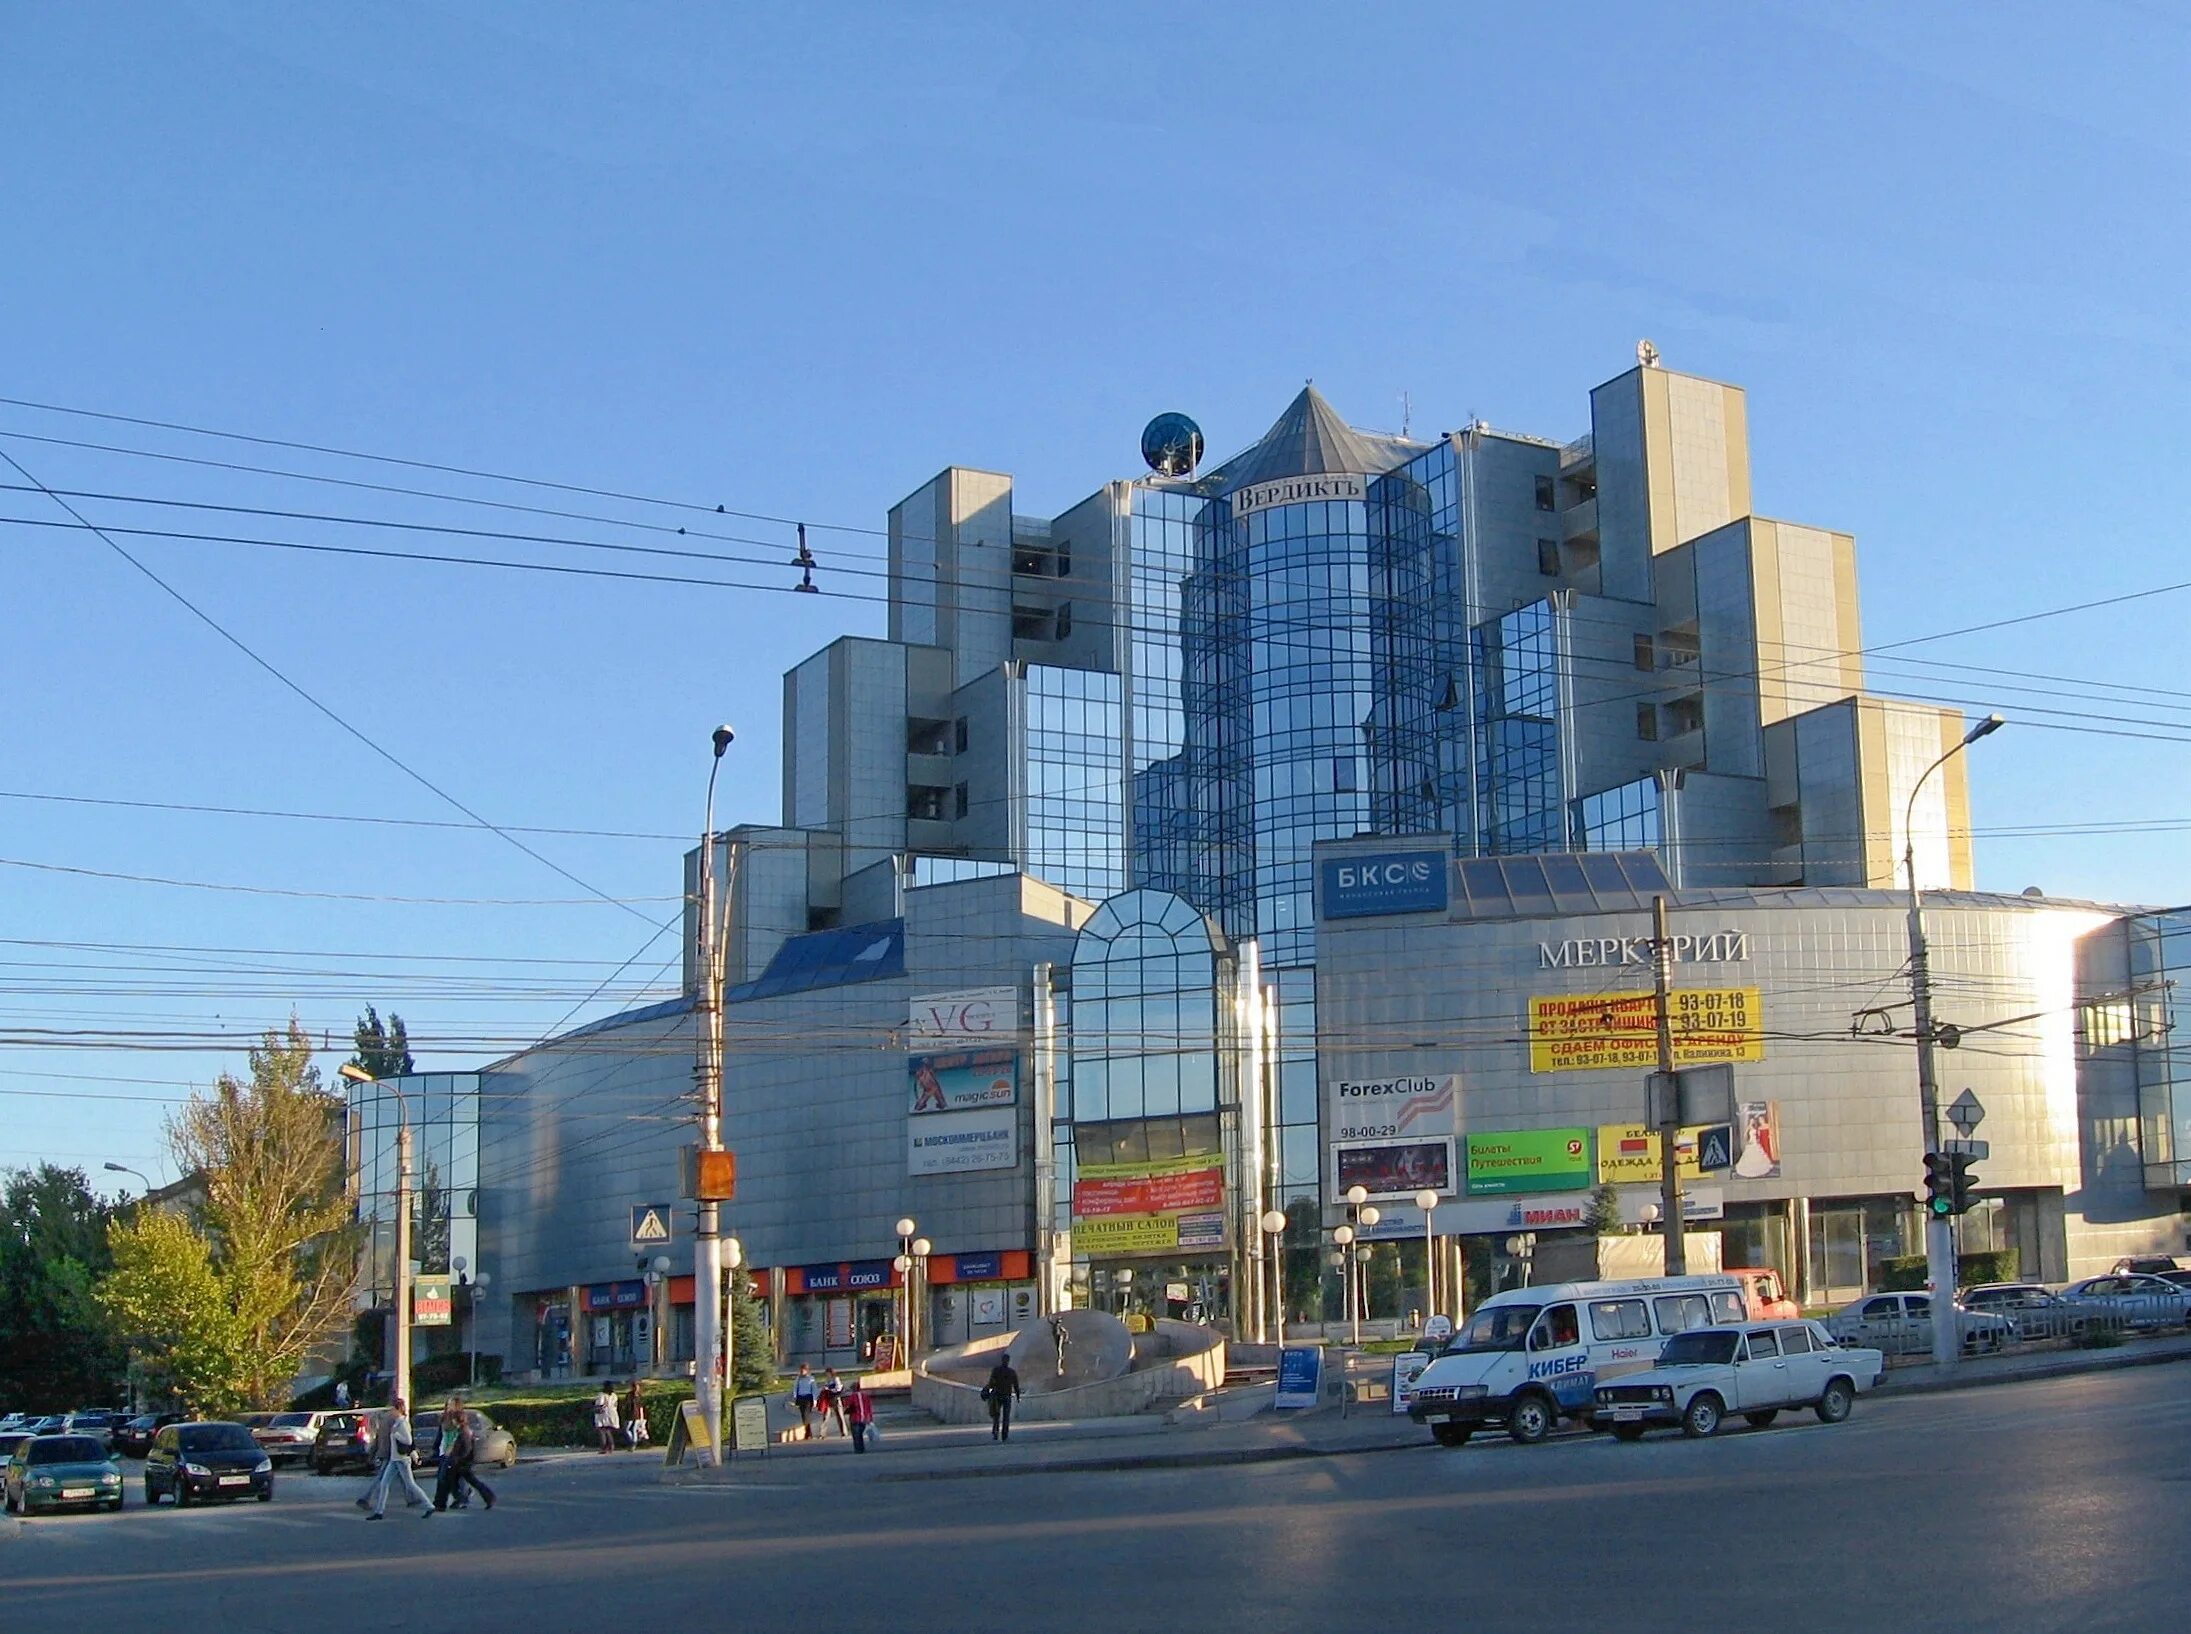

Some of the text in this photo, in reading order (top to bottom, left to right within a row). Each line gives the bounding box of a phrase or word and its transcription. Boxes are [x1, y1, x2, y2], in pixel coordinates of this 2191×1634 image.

[1339, 863, 1405, 888] БКС
[1680, 992, 1745, 1011] 93-07-18
[1681, 1010, 1746, 1029] 93-07-19
[1551, 1041, 1604, 1055] СДАЕМ
[1611, 1038, 1659, 1050] ОФИС
[1622, 1051, 1657, 1063] 93-07-1
[1341, 1125, 1396, 1138] 98-00-29
[1470, 1156, 1543, 1169] Путешествия
[1601, 1157, 1653, 1169] ОДЕЖДА
[1138, 1218, 1175, 1230] САЛОН
[1523, 1208, 1580, 1224] МИАН
[809, 1272, 881, 1288] БАНК СОЮЗ
[1612, 1348, 1637, 1359] Haier
[1529, 1355, 1588, 1379] КИБЕР
